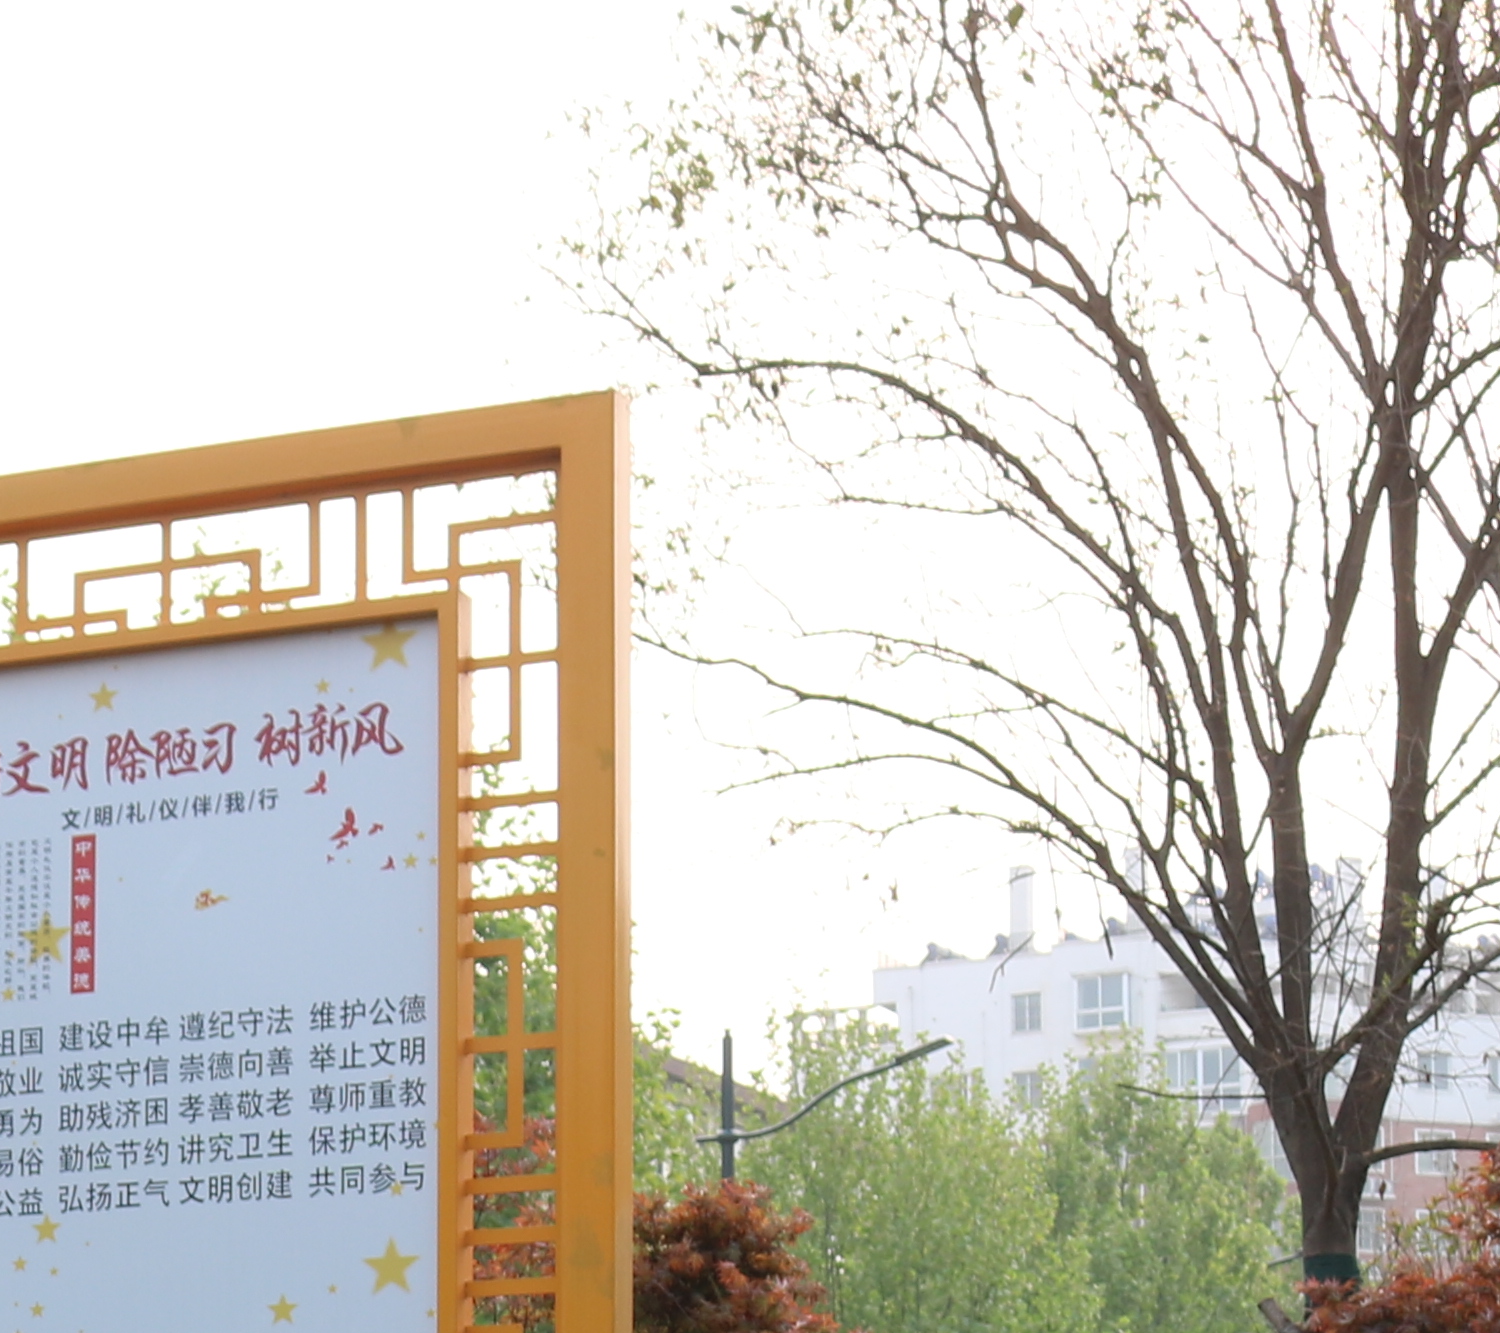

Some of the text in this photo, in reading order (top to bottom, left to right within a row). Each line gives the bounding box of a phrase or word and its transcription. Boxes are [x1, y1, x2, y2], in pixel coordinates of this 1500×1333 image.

[105, 722, 237, 784] 除陋习
[254, 702, 404, 767] 树新风
[59, 1016, 170, 1052] 建设中牟
[180, 1005, 294, 1042] 遵纪守法
[310, 994, 426, 1032] 维护公德
[59, 1055, 170, 1092] 诚实守信
[180, 1047, 294, 1082] 崇德向善
[310, 1036, 426, 1073] 举止文明
[59, 1097, 170, 1132] 助残济困
[180, 1087, 294, 1123] 孝善敬老
[310, 1077, 426, 1113] 尊师重教
[59, 1137, 170, 1173] 勤俭节约
[180, 1128, 294, 1165] 讲究卫生
[310, 1119, 426, 1155] 保护环境
[59, 1178, 170, 1214] 弘扬正气
[180, 1169, 294, 1206] 文明创建
[310, 1161, 426, 1197] 共同参与
